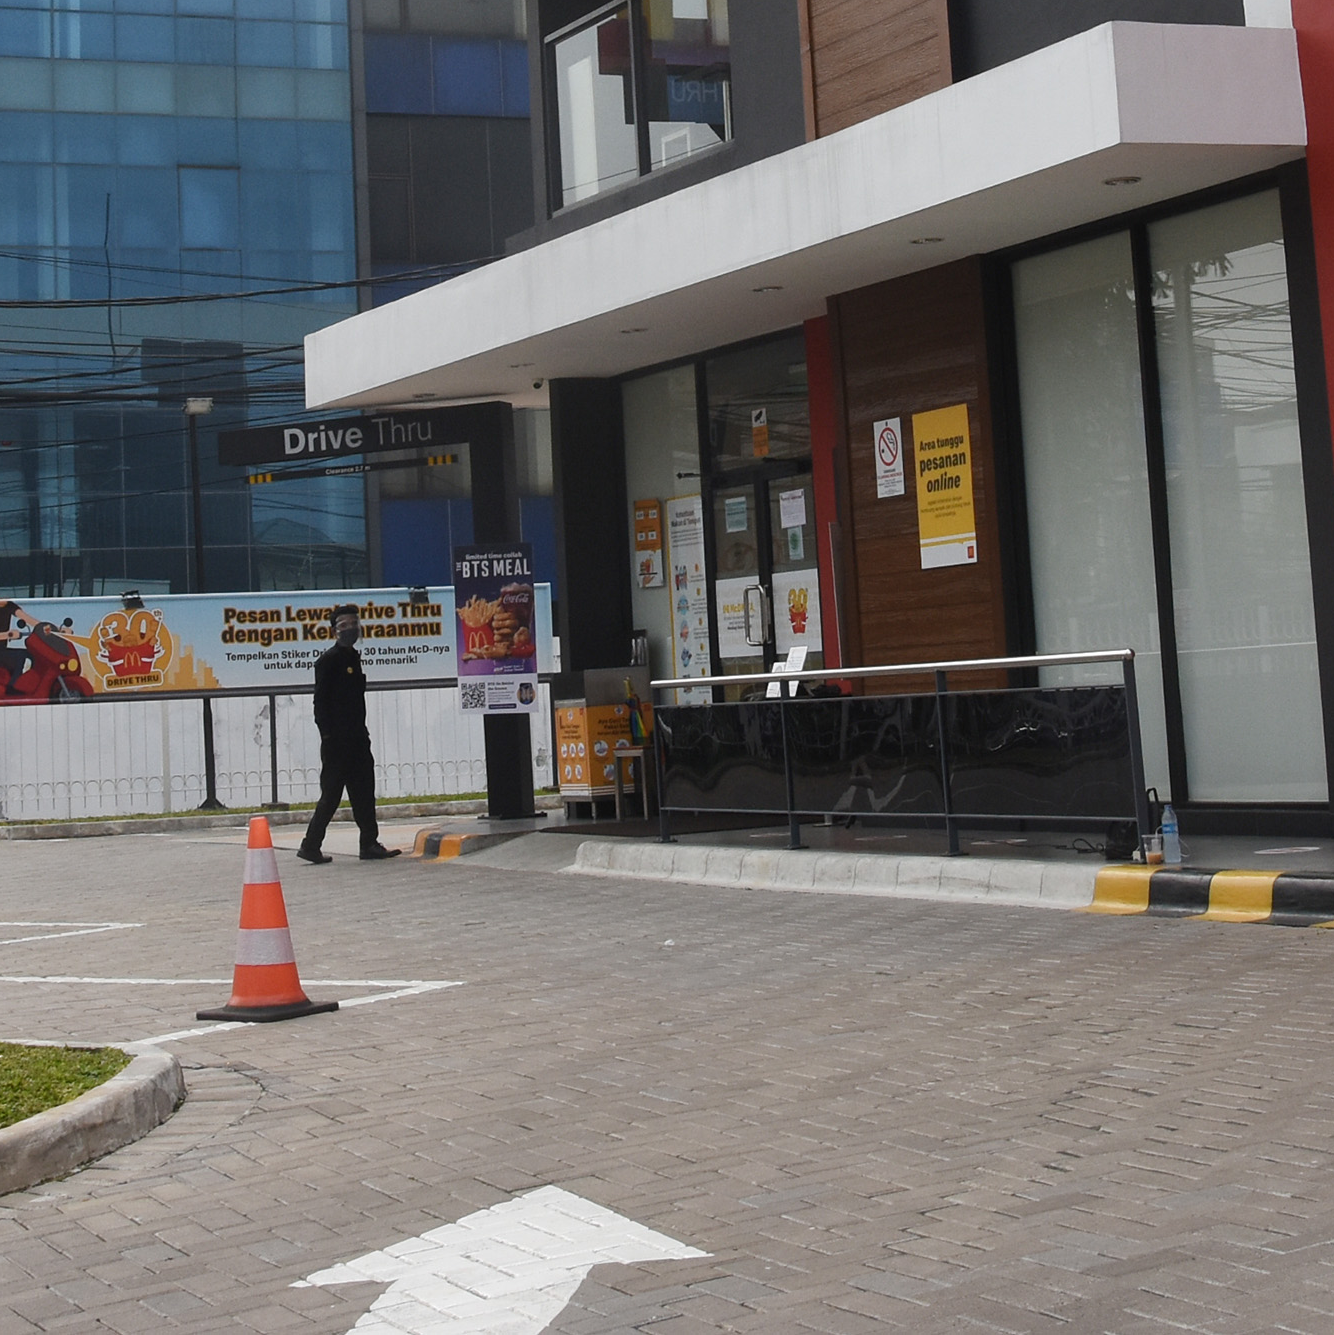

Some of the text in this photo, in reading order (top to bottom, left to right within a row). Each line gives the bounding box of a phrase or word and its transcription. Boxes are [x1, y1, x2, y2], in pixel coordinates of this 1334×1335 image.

[283, 418, 432, 455] Drive Thru
[919, 435, 964, 452] Area tunggu
[919, 451, 966, 477] pesanan
[926, 471, 961, 493] online
[462, 560, 489, 578] BTS
[493, 558, 531, 577] MEAL
[223, 607, 282, 624] Pesan
[284, 604, 341, 623] Lewa
[397, 602, 442, 619] Thru
[221, 624, 298, 647] dengan
[225, 651, 279, 663] Tempelkan
[281, 649, 310, 660] Stiker
[364, 647, 376, 655] 30
[378, 645, 406, 656] tahun
[407, 644, 450, 656] McD-nya
[264, 661, 293, 670] untuk
[375, 655, 418, 665] menarik!
[107, 674, 159, 686] DRIVE THRU
